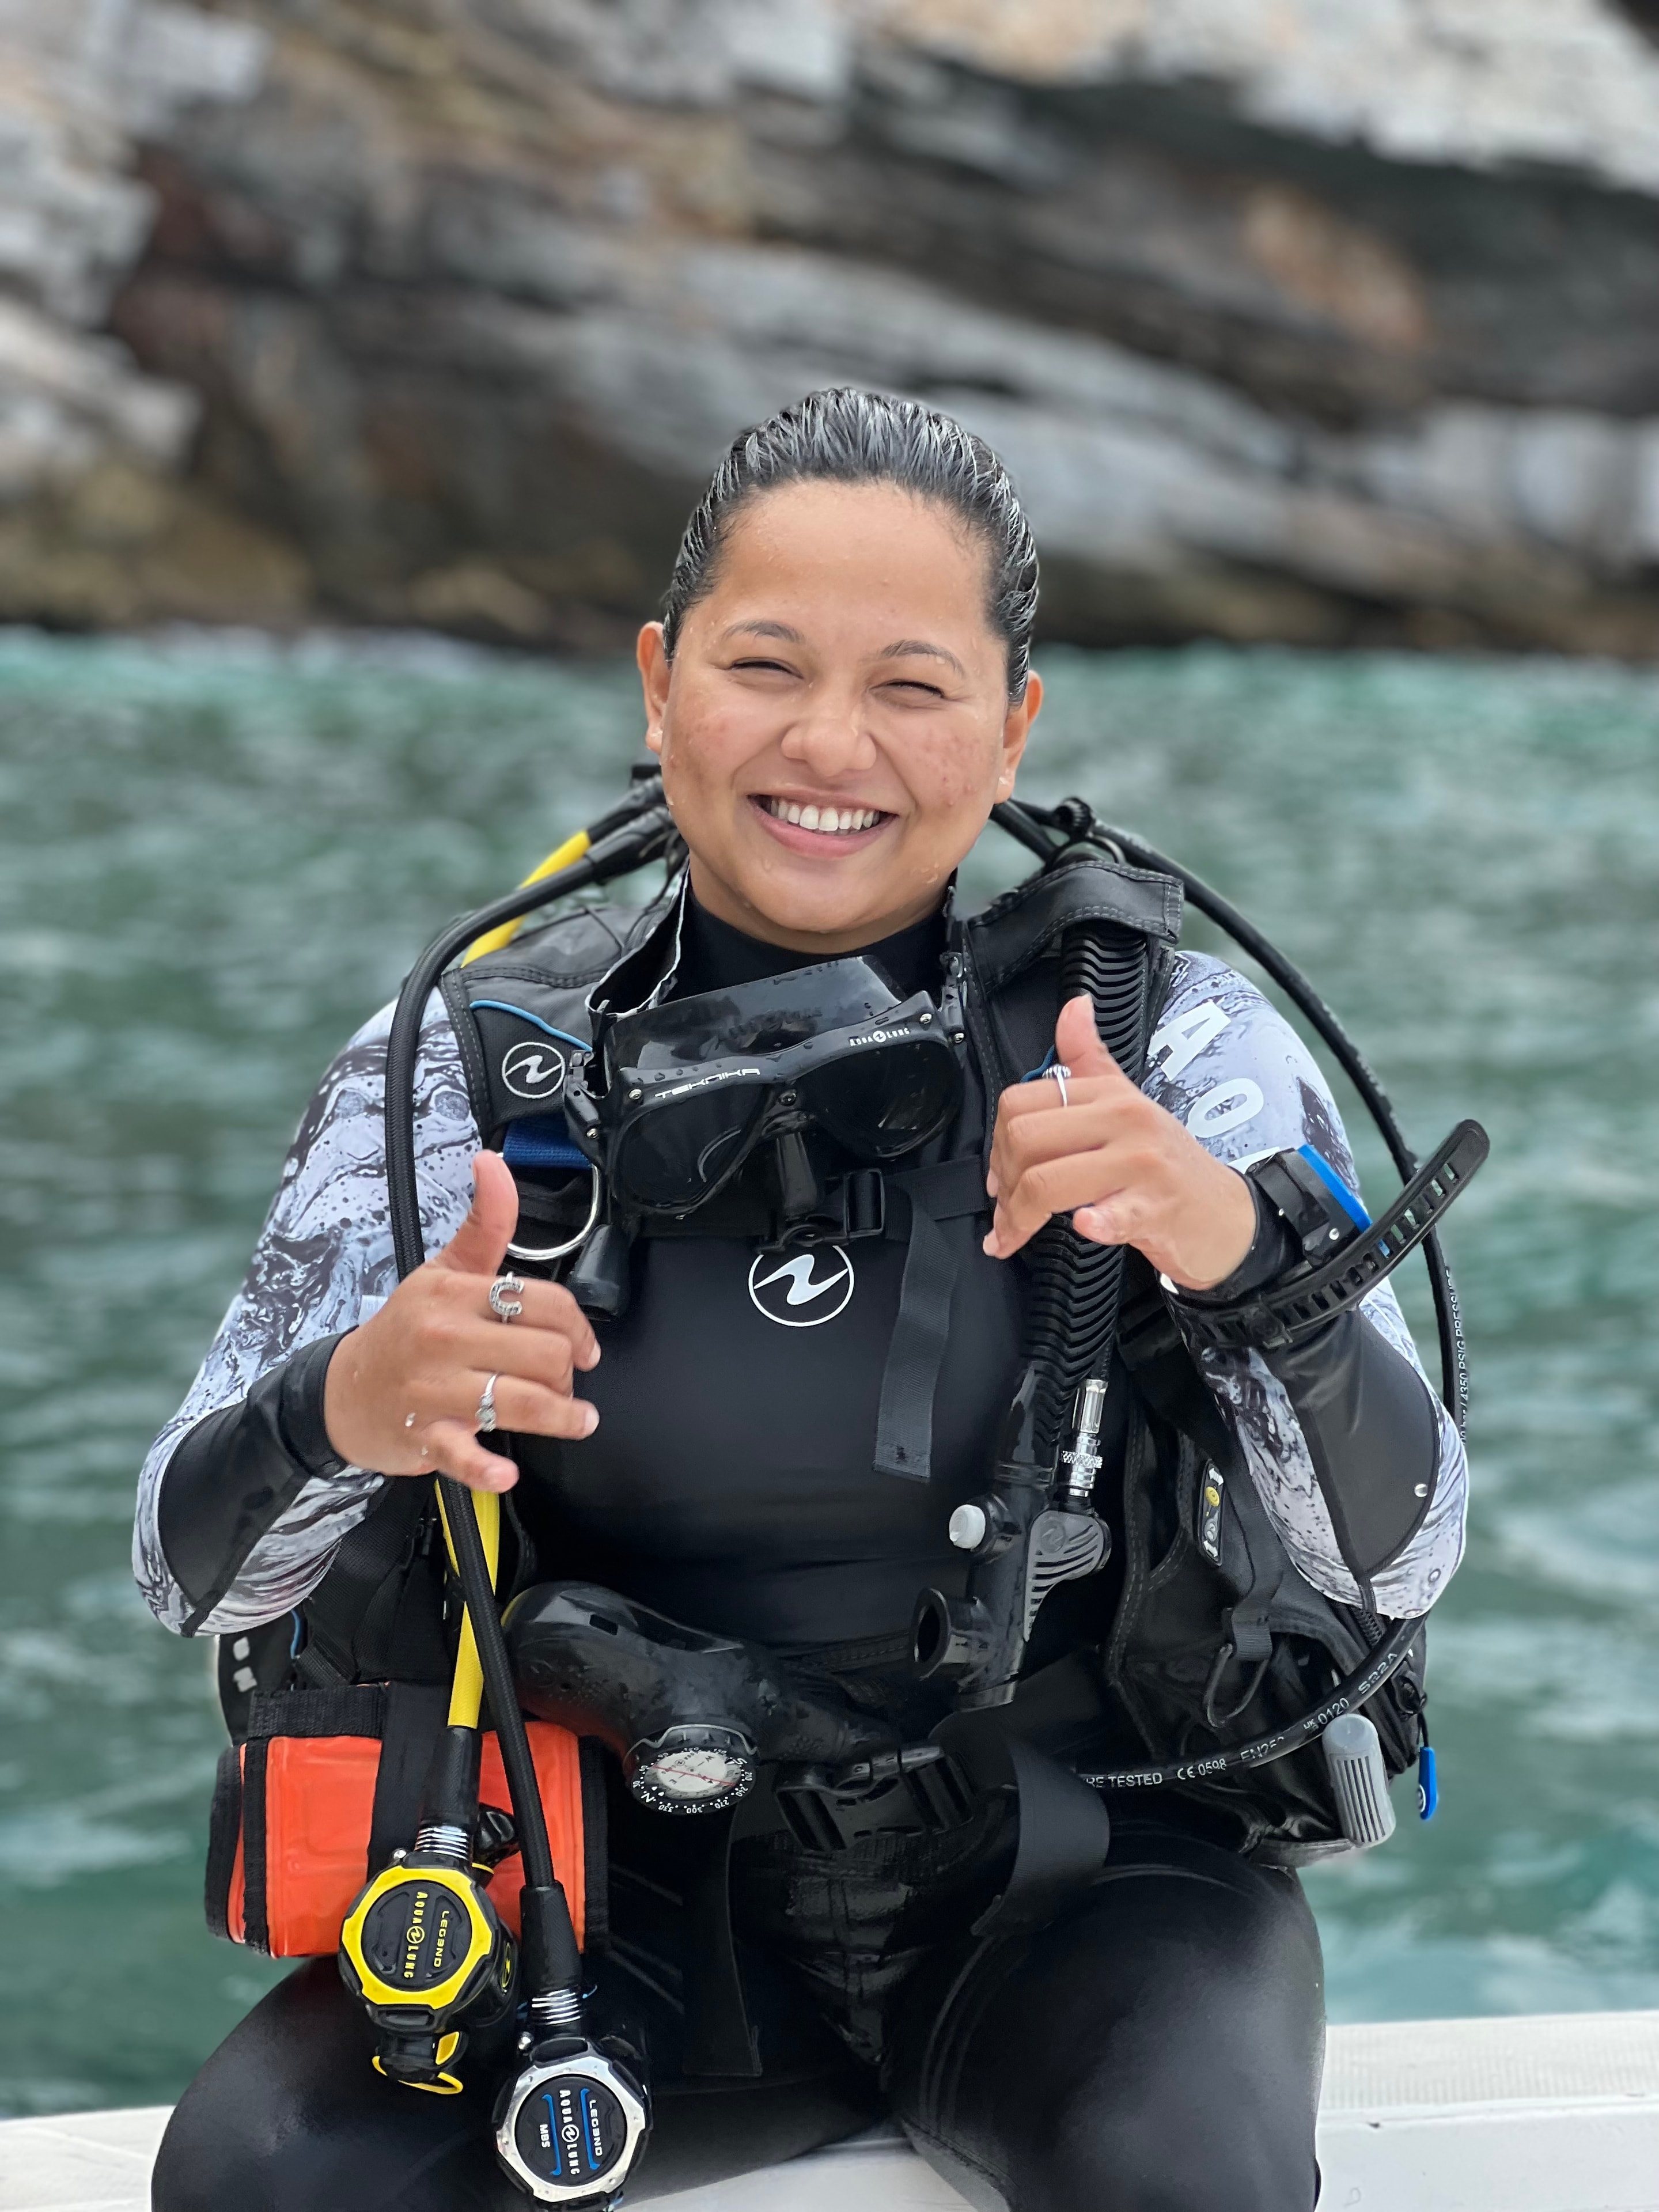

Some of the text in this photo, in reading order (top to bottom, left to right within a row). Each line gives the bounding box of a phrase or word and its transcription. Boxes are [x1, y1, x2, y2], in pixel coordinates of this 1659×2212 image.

[1317, 1698, 1350, 1725] 0120
[735, 1786, 749, 1798] 240
[1107, 1772, 1163, 1788] TESTED
[714, 1799, 730, 1810] 270
[404, 1891, 429, 1979] AQUA LUNG
[539, 2123, 551, 2149] MBS
[559, 2089, 581, 2175] AQUA LUNG
